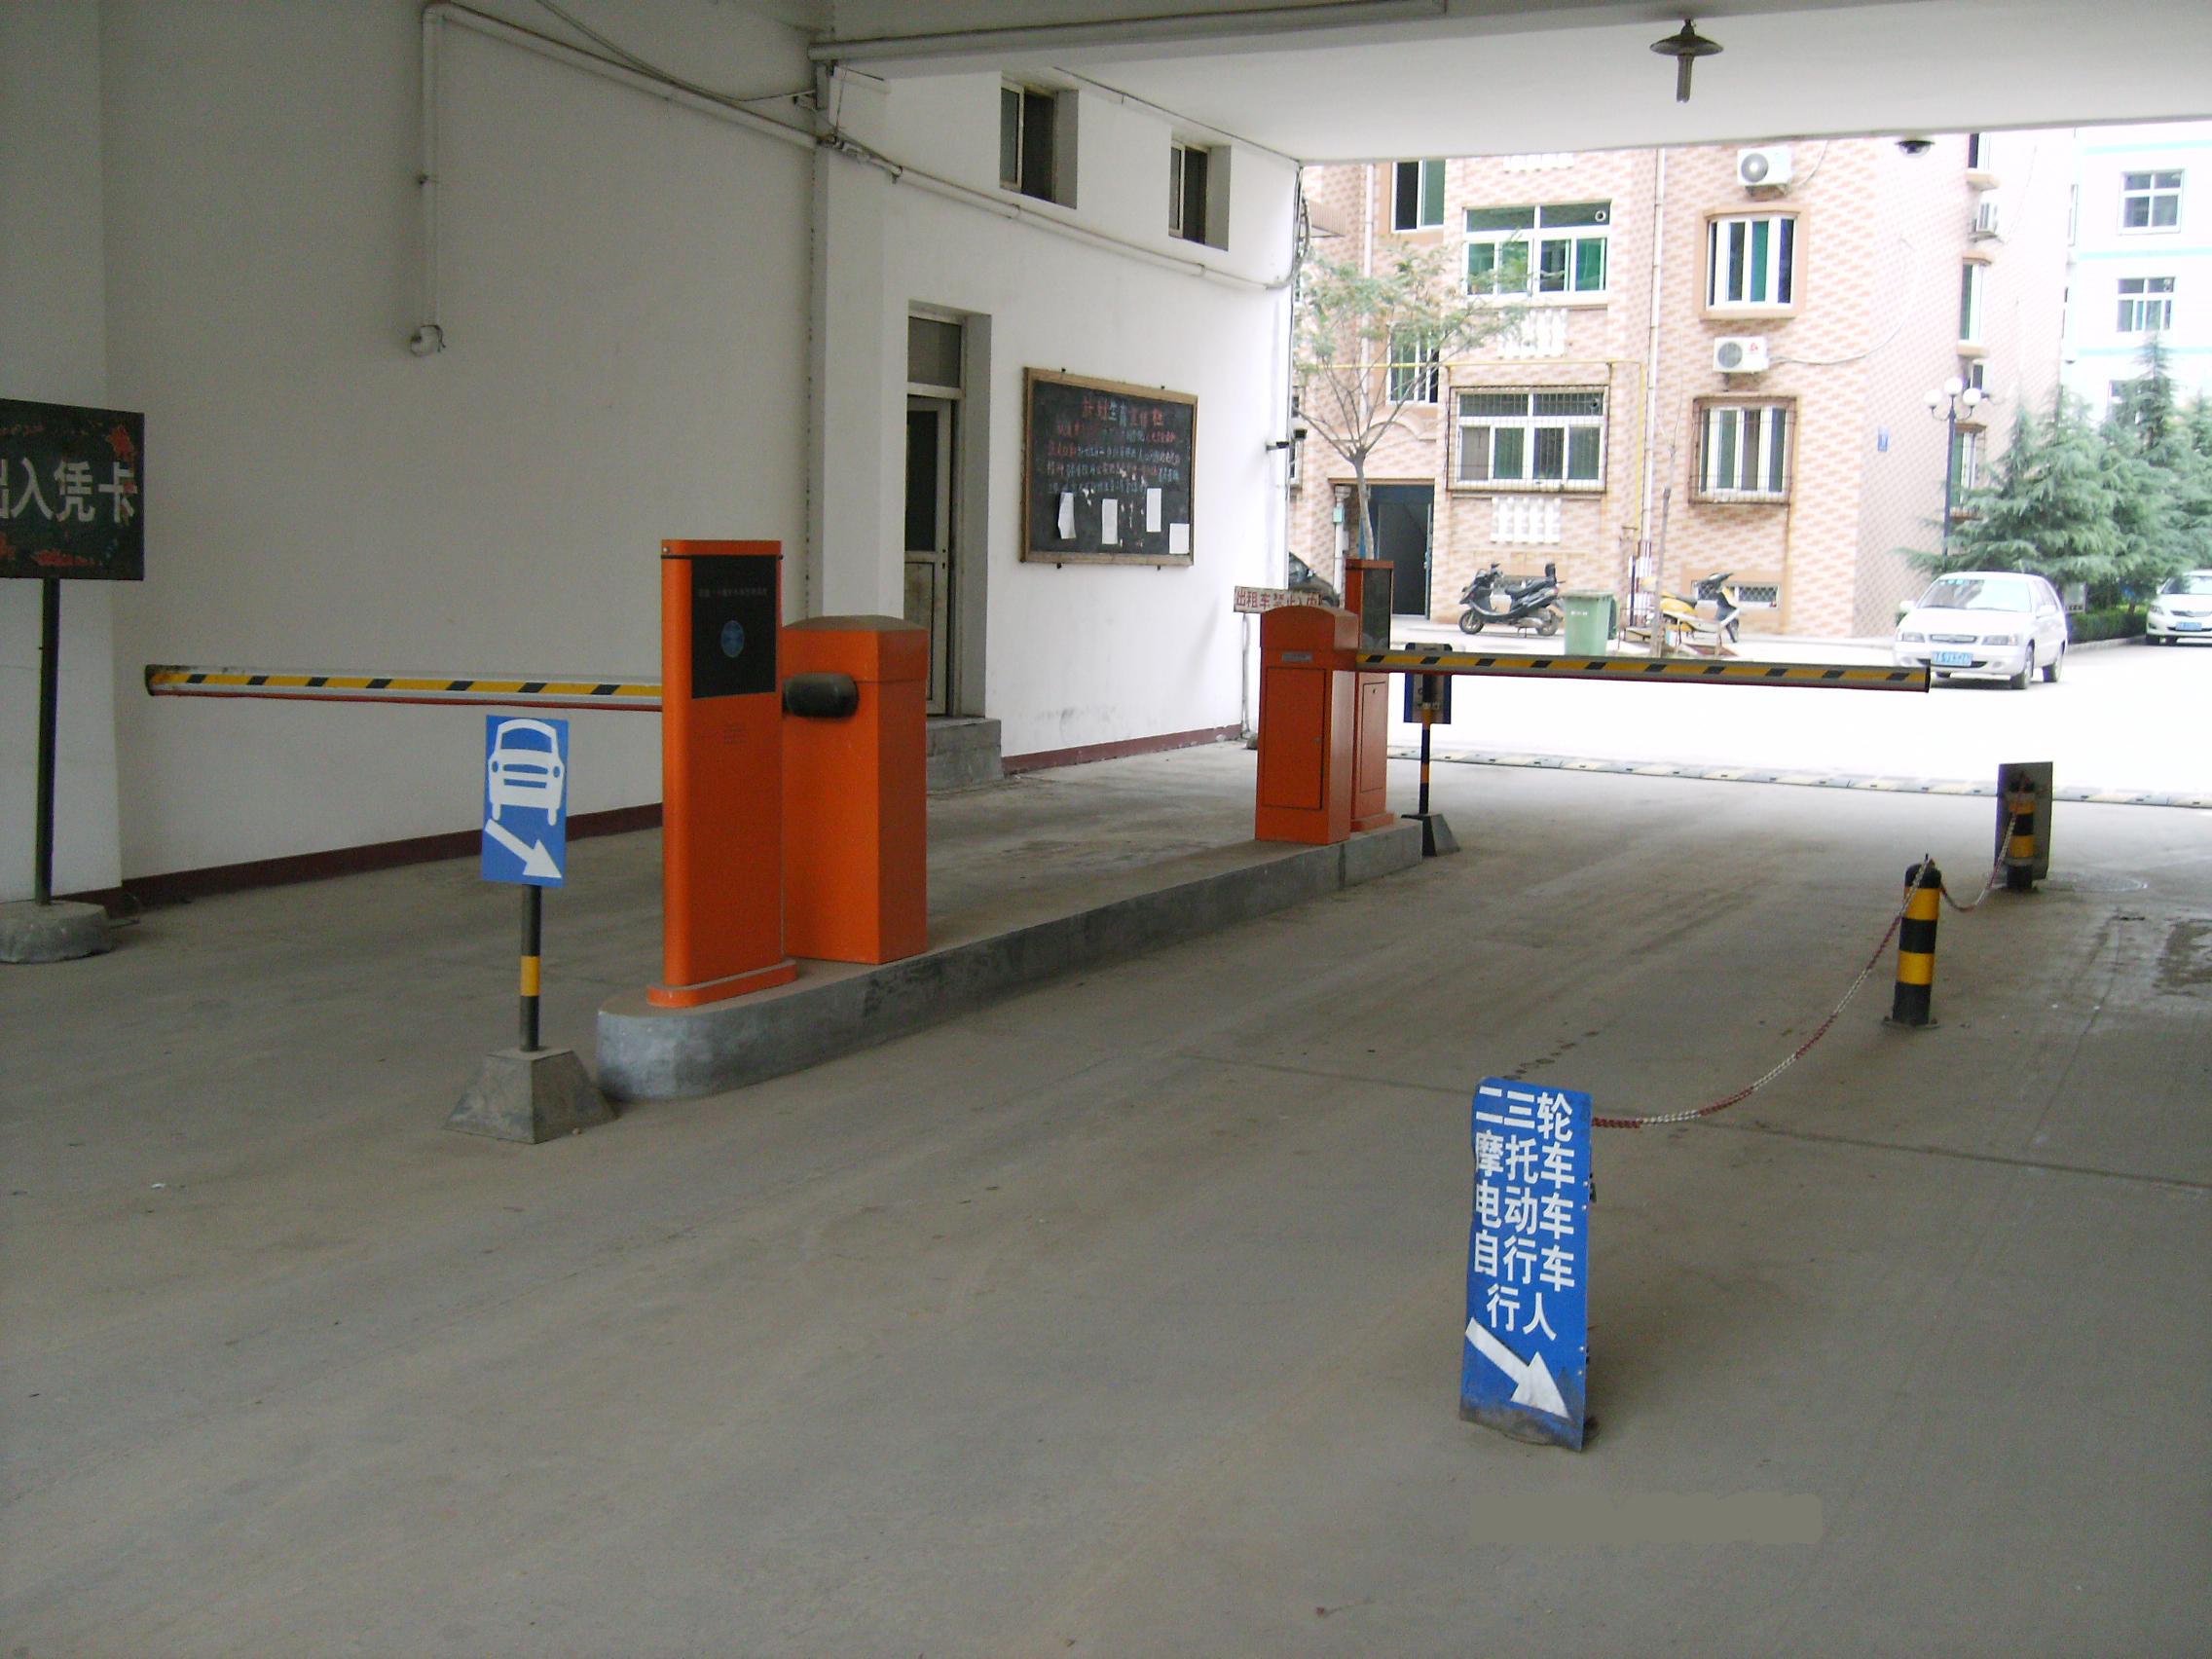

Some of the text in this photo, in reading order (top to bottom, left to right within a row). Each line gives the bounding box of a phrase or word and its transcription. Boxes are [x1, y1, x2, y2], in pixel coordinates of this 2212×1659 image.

[0, 455, 138, 524] 入凭卡
[1476, 1086, 1572, 1142] 二三轮
[1475, 1129, 1575, 1189] 摩托车
[1475, 1179, 1574, 1239] 电动车
[1474, 1229, 1575, 1292] 自行车
[1487, 1283, 1557, 1341] 行人
